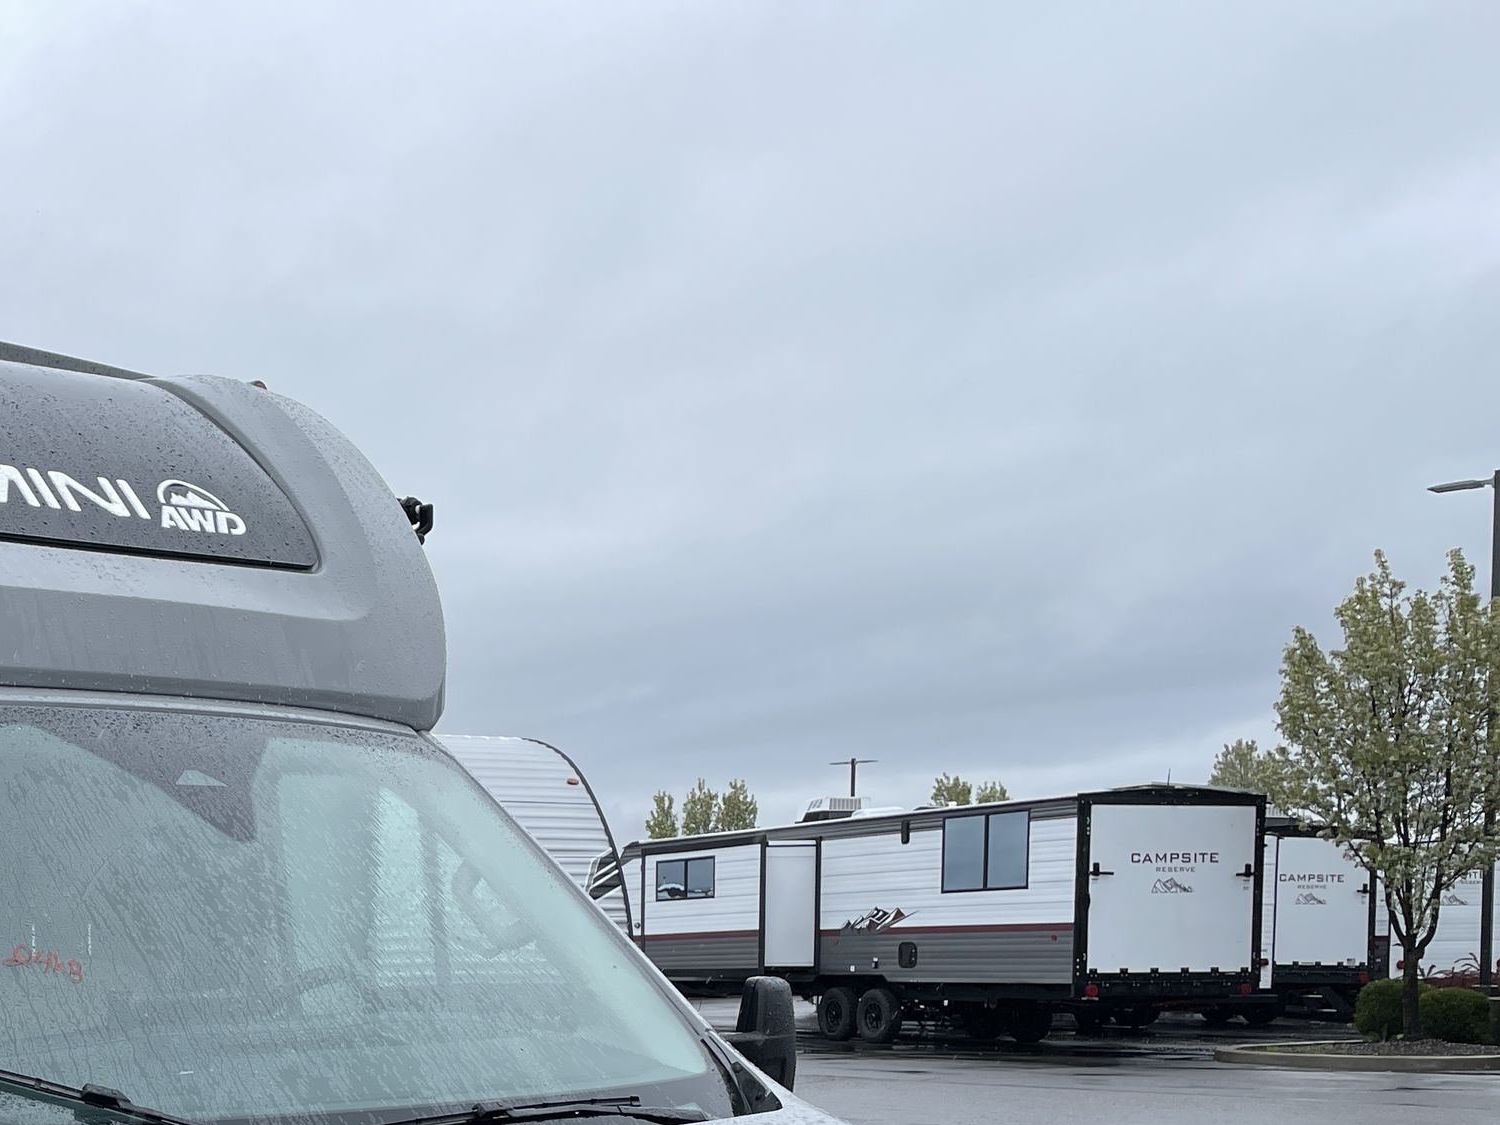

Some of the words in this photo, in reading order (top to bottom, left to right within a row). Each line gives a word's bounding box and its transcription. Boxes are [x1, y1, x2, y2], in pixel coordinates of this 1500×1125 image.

[161, 505, 247, 535] AWD
[1130, 852, 1220, 864] CAMPSITE
[1279, 873, 1345, 883] CAMPSITE
